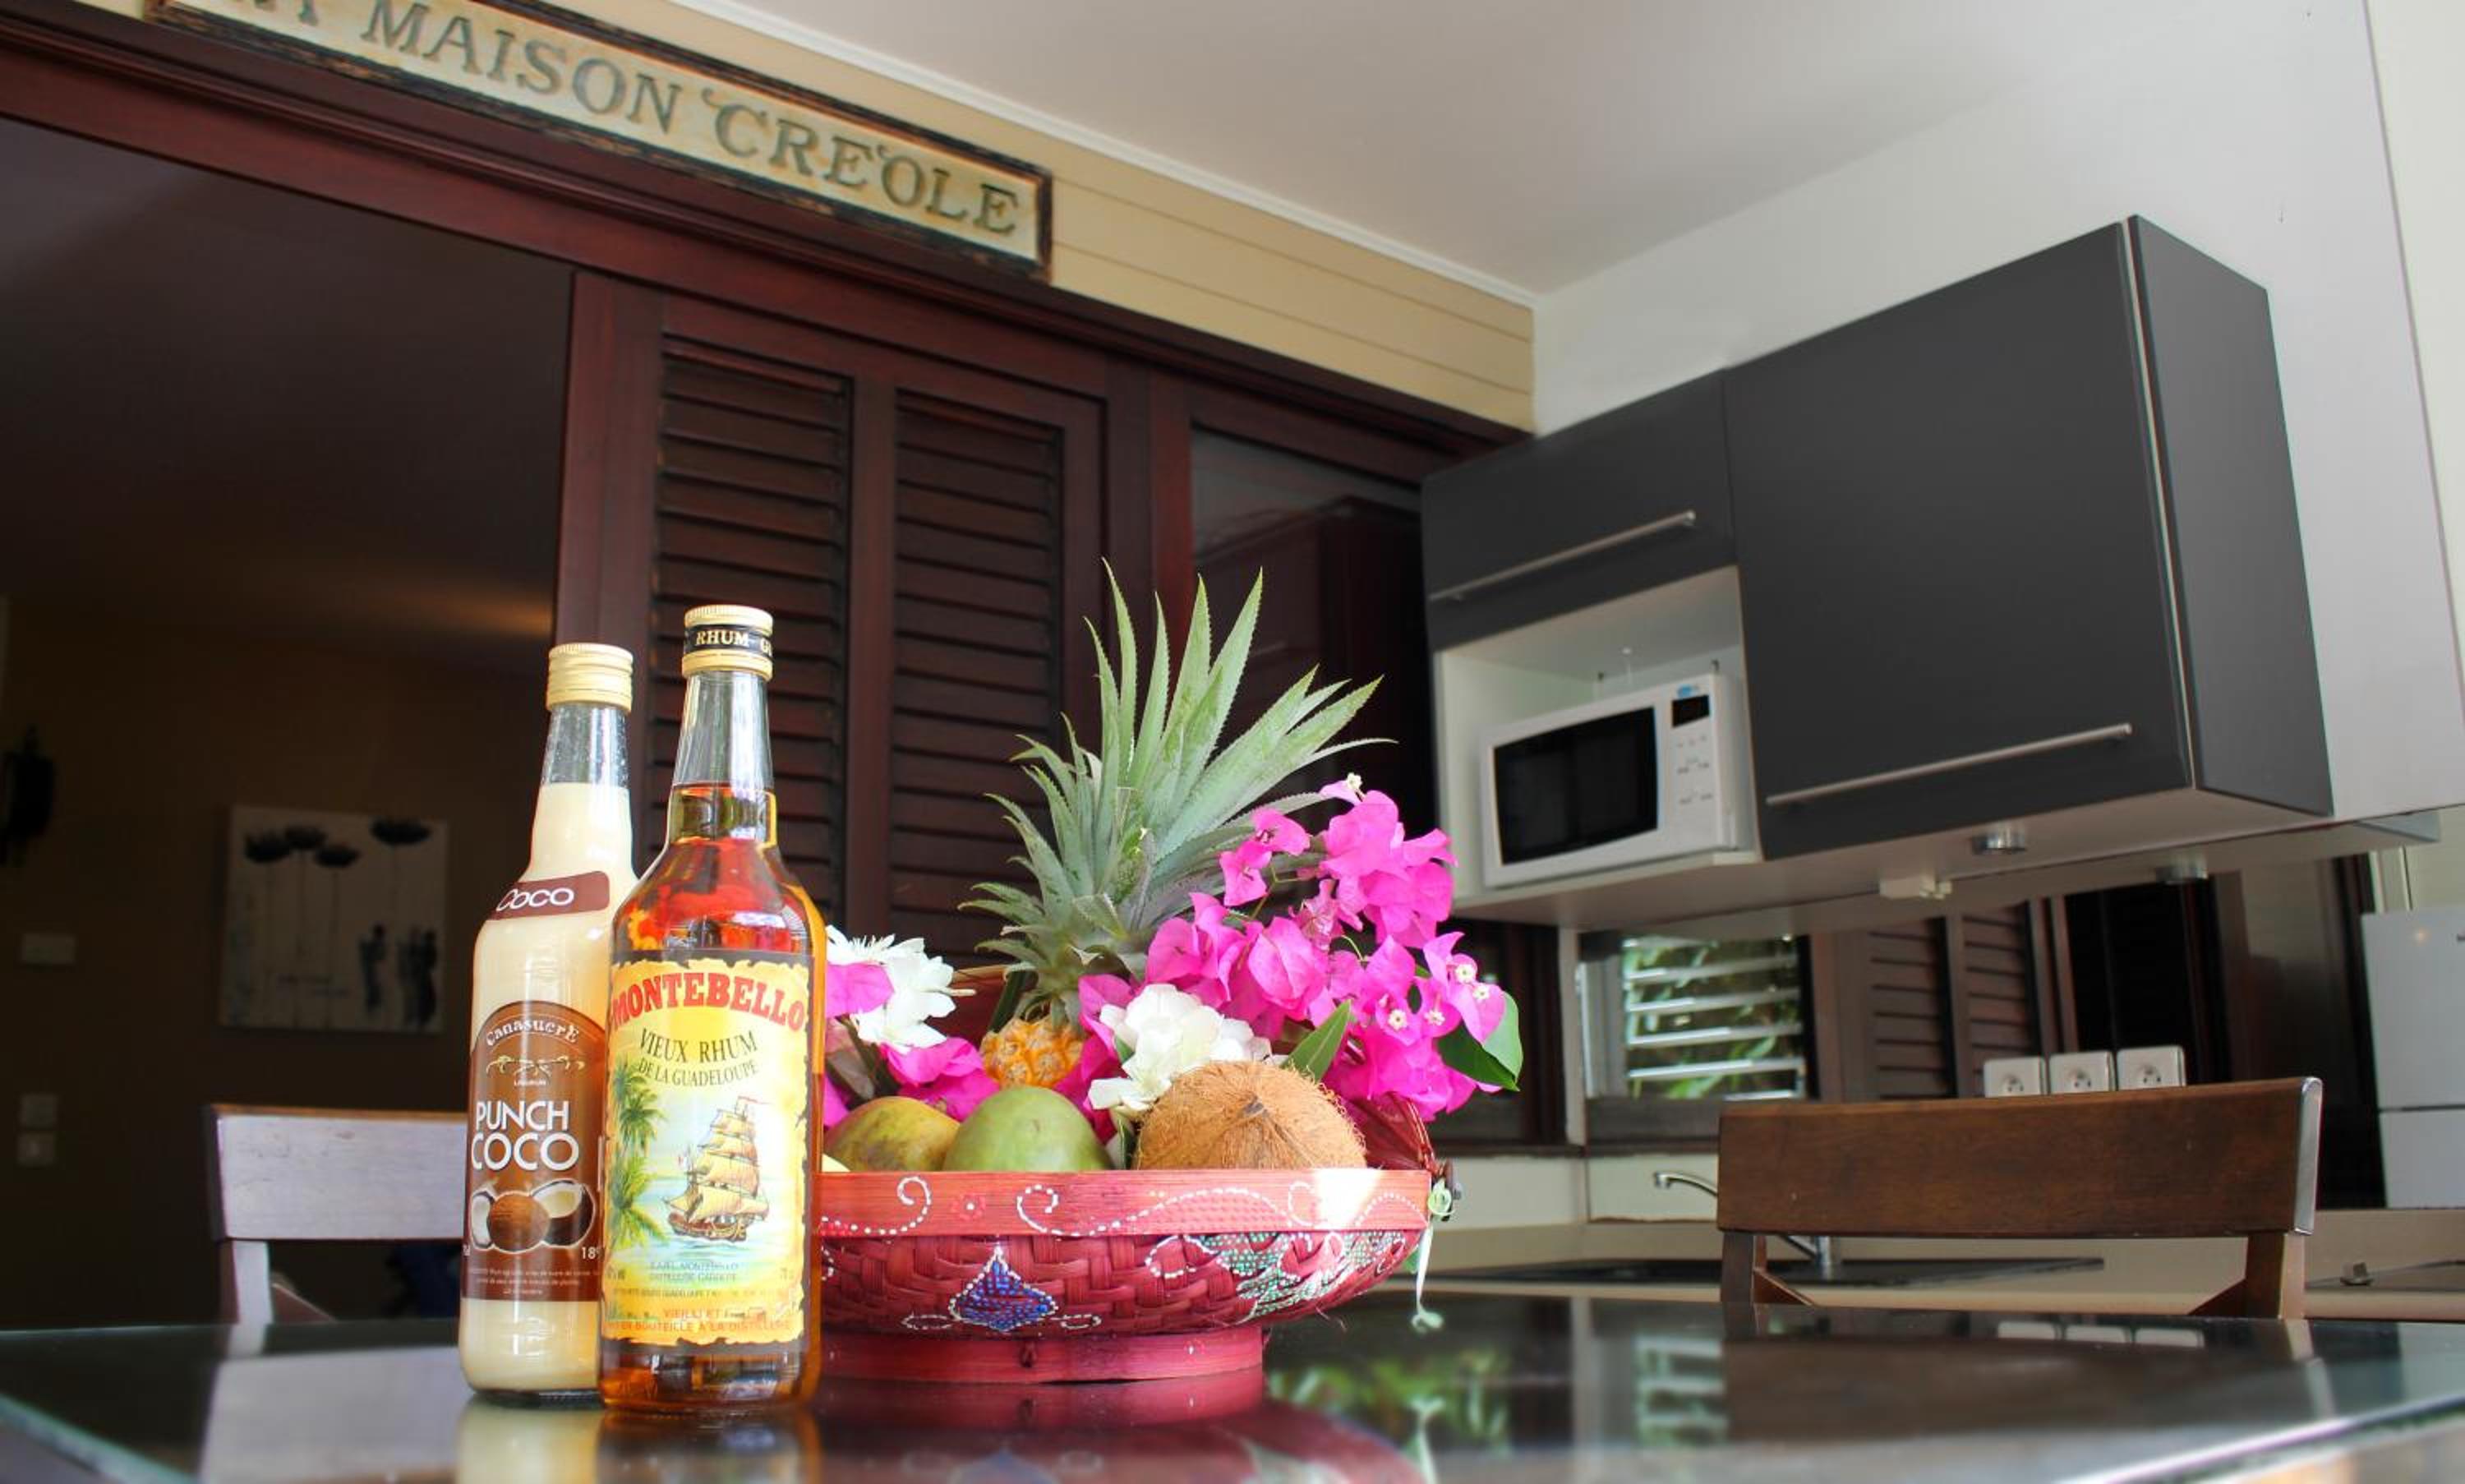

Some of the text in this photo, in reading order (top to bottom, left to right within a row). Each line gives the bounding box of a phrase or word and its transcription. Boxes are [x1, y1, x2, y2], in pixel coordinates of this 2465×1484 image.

[359, 0, 682, 134] MAISON
[695, 629, 750, 648] RHUM
[496, 887, 574, 911] COCO
[610, 972, 805, 1032] MONTEBELLO
[640, 1028, 758, 1063] VIEUX RHUM
[638, 1058, 758, 1086] DE LA GUADELOUPE
[476, 1100, 569, 1131] PUNCH
[472, 1131, 579, 1171] COCO
